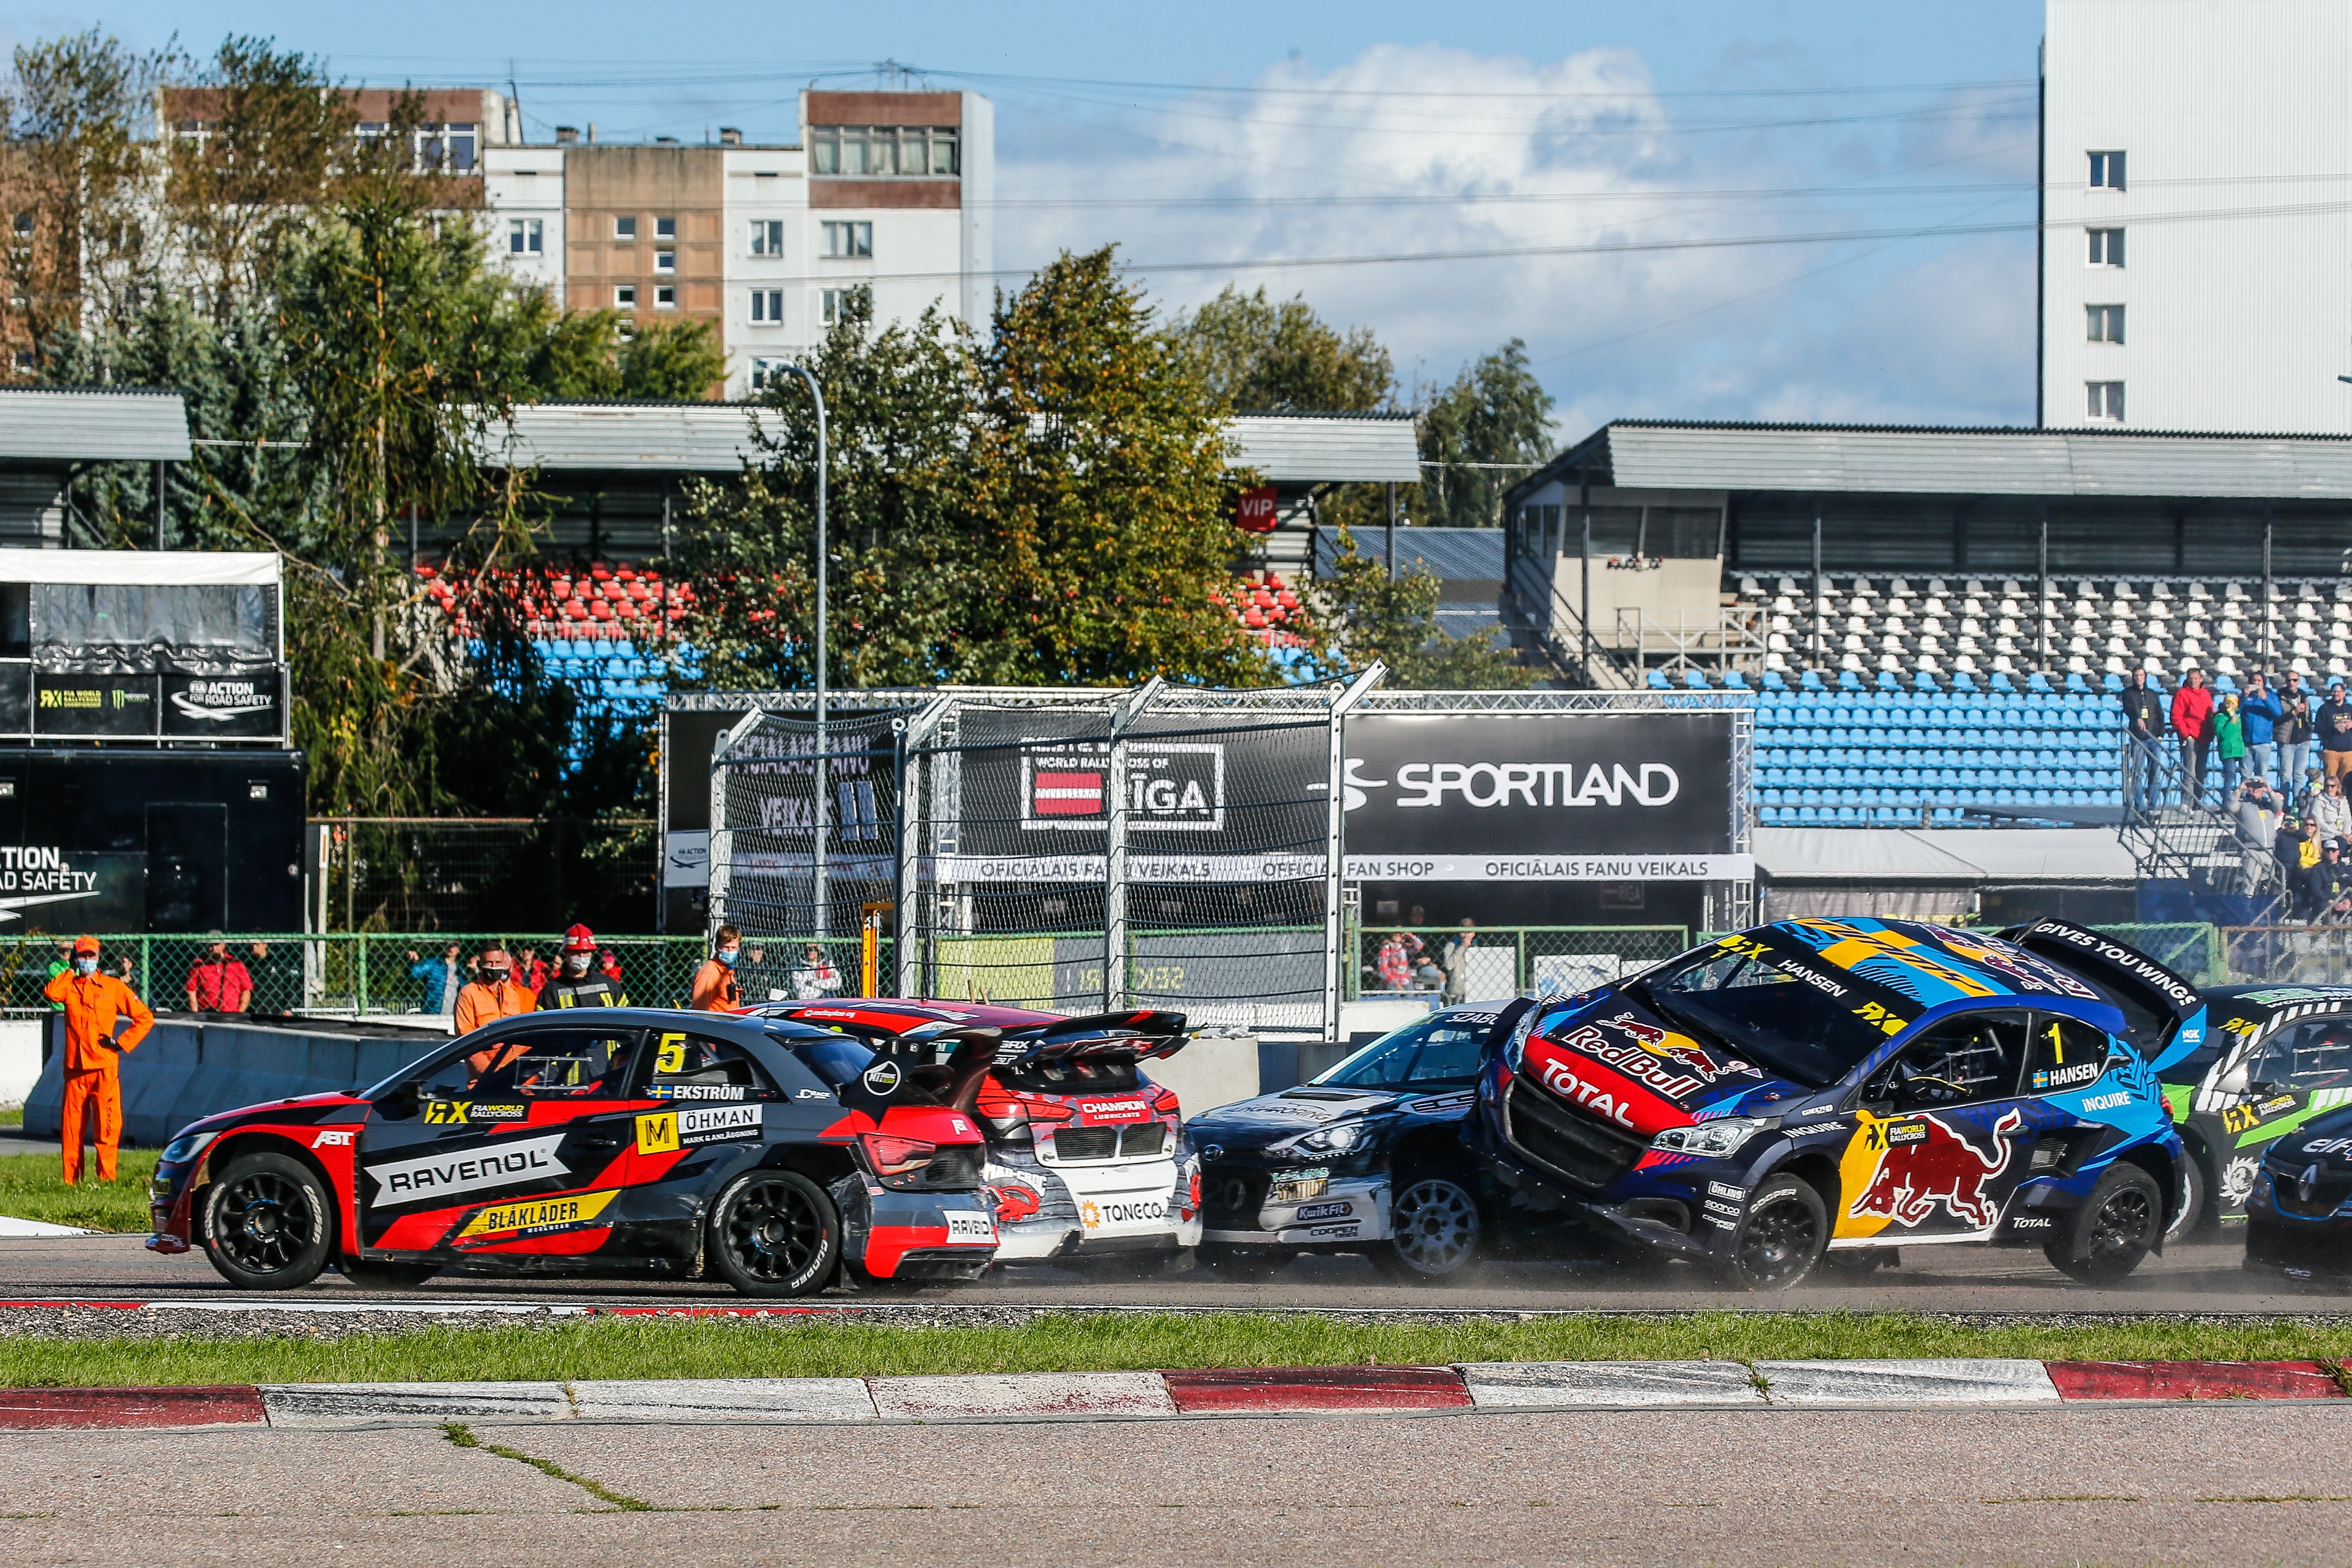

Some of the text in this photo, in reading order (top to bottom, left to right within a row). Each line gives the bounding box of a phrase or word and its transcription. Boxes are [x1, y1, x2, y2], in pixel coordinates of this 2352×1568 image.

[1241, 499, 1273, 516] VIP
[208, 682, 254, 695] ACTION
[205, 694, 233, 706] ROAD
[234, 695, 272, 706] SAFETY
[1035, 757, 1078, 768] WORLD
[1152, 757, 1168, 768] OF
[1396, 762, 1679, 807] SPORTLAND
[1107, 772, 1209, 816] ĪGA
[0, 846, 59, 870] TION
[1348, 862, 1381, 876] FAN
[1387, 862, 1434, 876] SHOP
[1486, 859, 1708, 876] OFICIĀLAIS FANU VEIKALS
[21, 871, 97, 891] SAFETY
[2035, 922, 2198, 1007] GIVES YOU WINGS
[1778, 959, 1848, 997] HANSEN
[2182, 1029, 2200, 1039] NGK
[2048, 1022, 2063, 1064] 1
[657, 1033, 686, 1073] 5
[2049, 1062, 2099, 1086] HANSEN
[673, 1083, 745, 1100] EKSTRÖM
[1543, 1058, 1634, 1128] TOTAL
[1081, 1101, 1146, 1113] CHAMPION
[686, 1108, 754, 1130] ÖHMAN
[645, 1118, 670, 1147] M
[1890, 1124, 1926, 1135] FIA WORLD
[1890, 1132, 1926, 1142] RALLYCROSS
[311, 1131, 354, 1149] ABT
[2302, 1138, 2352, 1153] elf
[390, 1149, 548, 1193] RAVENOL
[1711, 1183, 1744, 1199] ÖHLINS
[1704, 1199, 1741, 1215] sparco
[1749, 1188, 1797, 1213] COOPER
[488, 1202, 579, 1230] BLÅKLÄDER
[1702, 1214, 1737, 1228] COOPER
[2013, 1217, 2051, 1228] TOTAL
[527, 1223, 570, 1233] WORKWEAR
[1310, 1226, 1359, 1236] COOPER
[791, 1239, 828, 1288] COOPER
